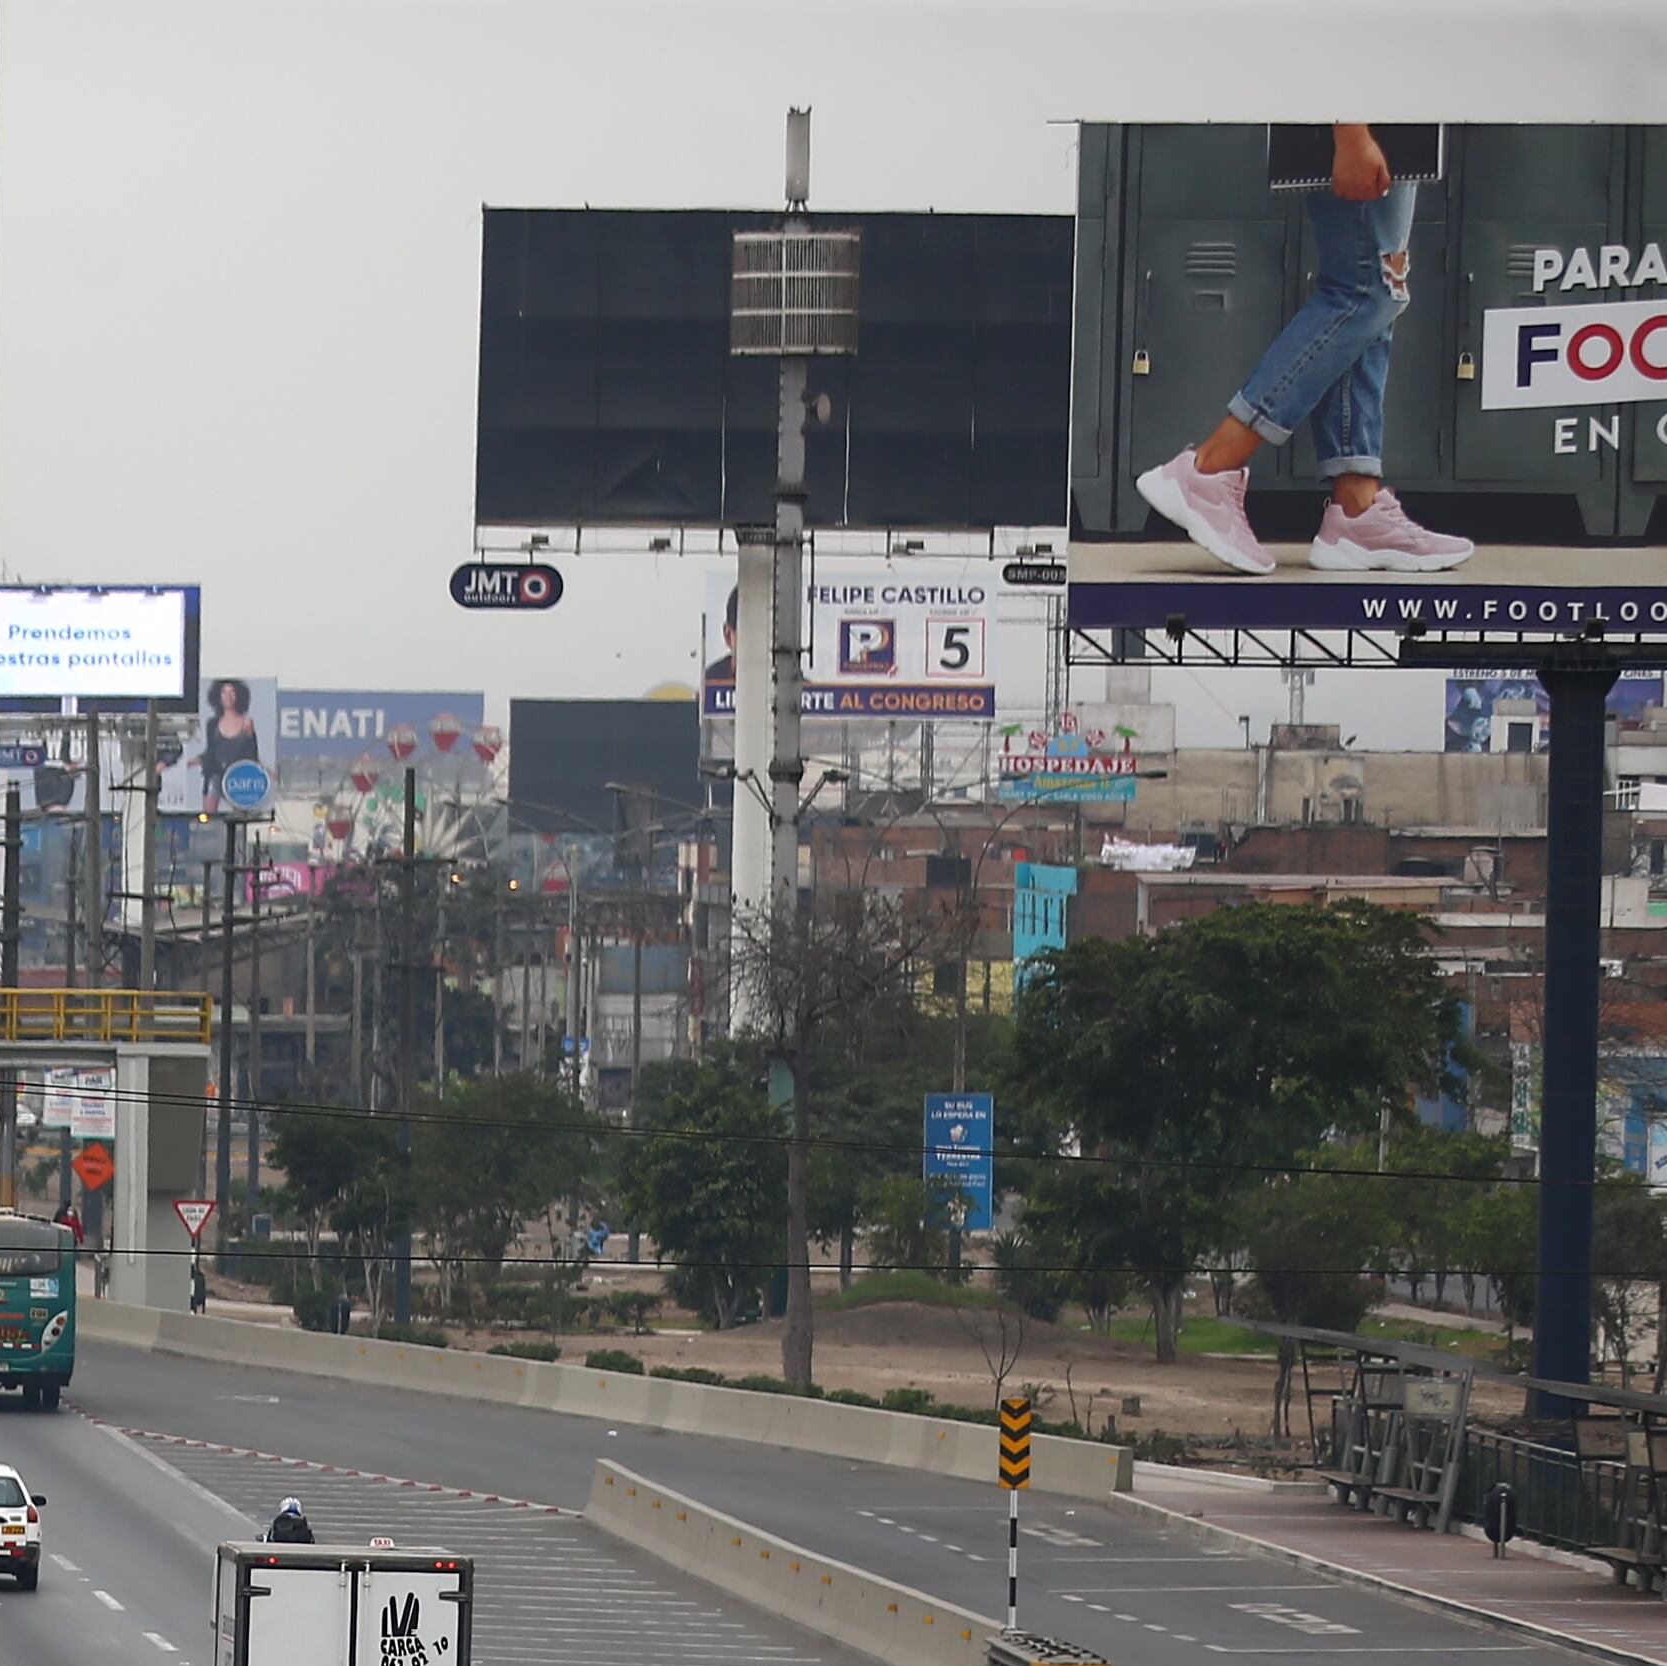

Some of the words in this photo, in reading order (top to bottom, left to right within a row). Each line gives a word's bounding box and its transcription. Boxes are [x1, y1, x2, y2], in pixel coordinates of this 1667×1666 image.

[1533, 243, 1667, 291] PARA
[1554, 416, 1619, 453] EN
[465, 570, 518, 594] JMT
[808, 587, 874, 604] FELIPE
[881, 587, 985, 605] CASTILLO
[9, 624, 131, 641] Prendemos
[940, 627, 970, 668] 5
[68, 650, 172, 669] pantallas
[839, 692, 863, 708] AL
[870, 692, 985, 709] CONGRESO
[280, 707, 385, 740] ENATI
[999, 757, 1136, 773] HOSPEDAJE
[380, 1637, 425, 1657] CARGA
